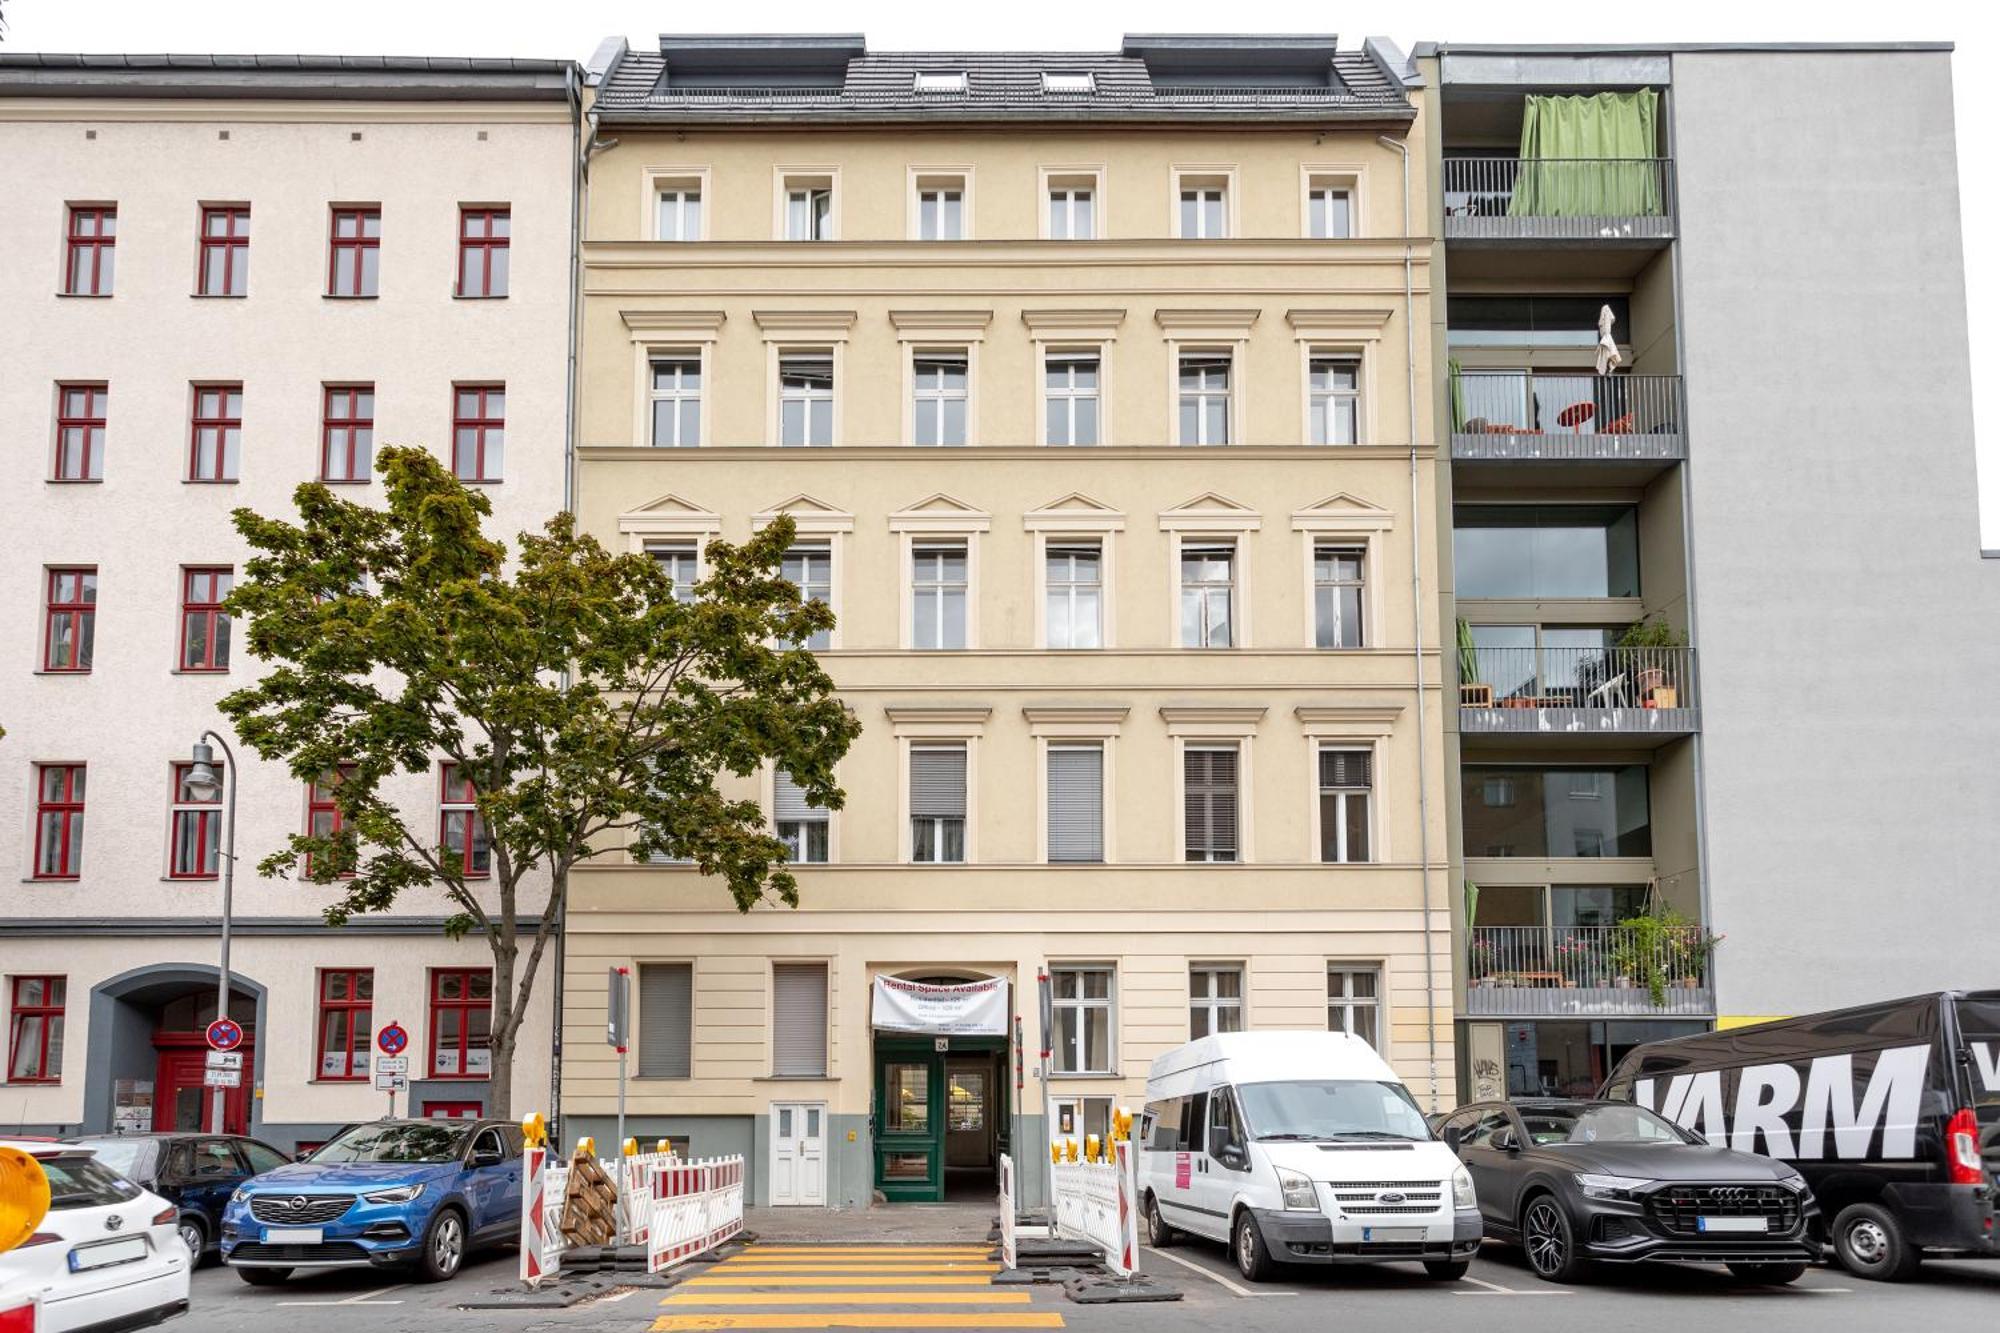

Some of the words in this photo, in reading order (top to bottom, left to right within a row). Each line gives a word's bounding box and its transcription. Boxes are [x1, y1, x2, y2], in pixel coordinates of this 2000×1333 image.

[883, 979, 915, 991] Rental
[919, 985, 950, 993] Space
[953, 983, 998, 992] Available
